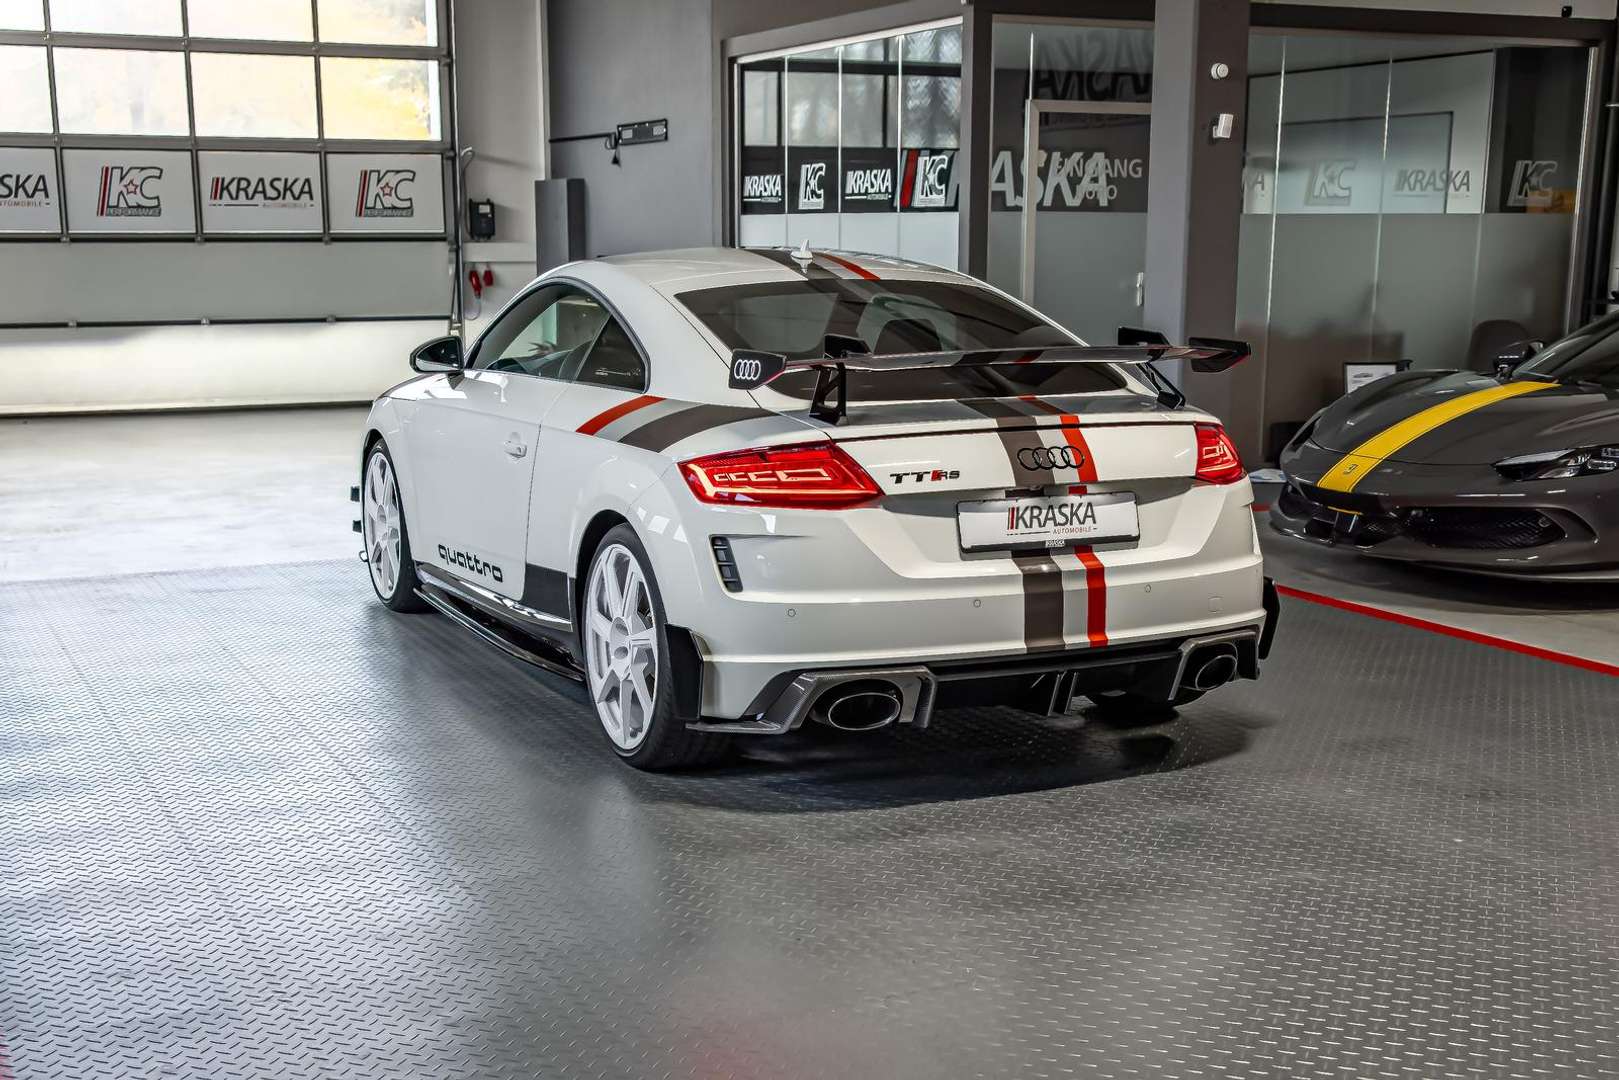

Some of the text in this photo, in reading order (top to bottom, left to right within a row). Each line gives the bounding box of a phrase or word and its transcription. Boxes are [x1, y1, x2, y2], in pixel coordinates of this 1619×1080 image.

[0, 174, 49, 198] SKA
[218, 177, 314, 200] KRASKA
[746, 175, 782, 196] KRASKA
[848, 168, 892, 194] KRASKA
[1015, 501, 1097, 530] KRASKA
[437, 543, 504, 583] quattro
